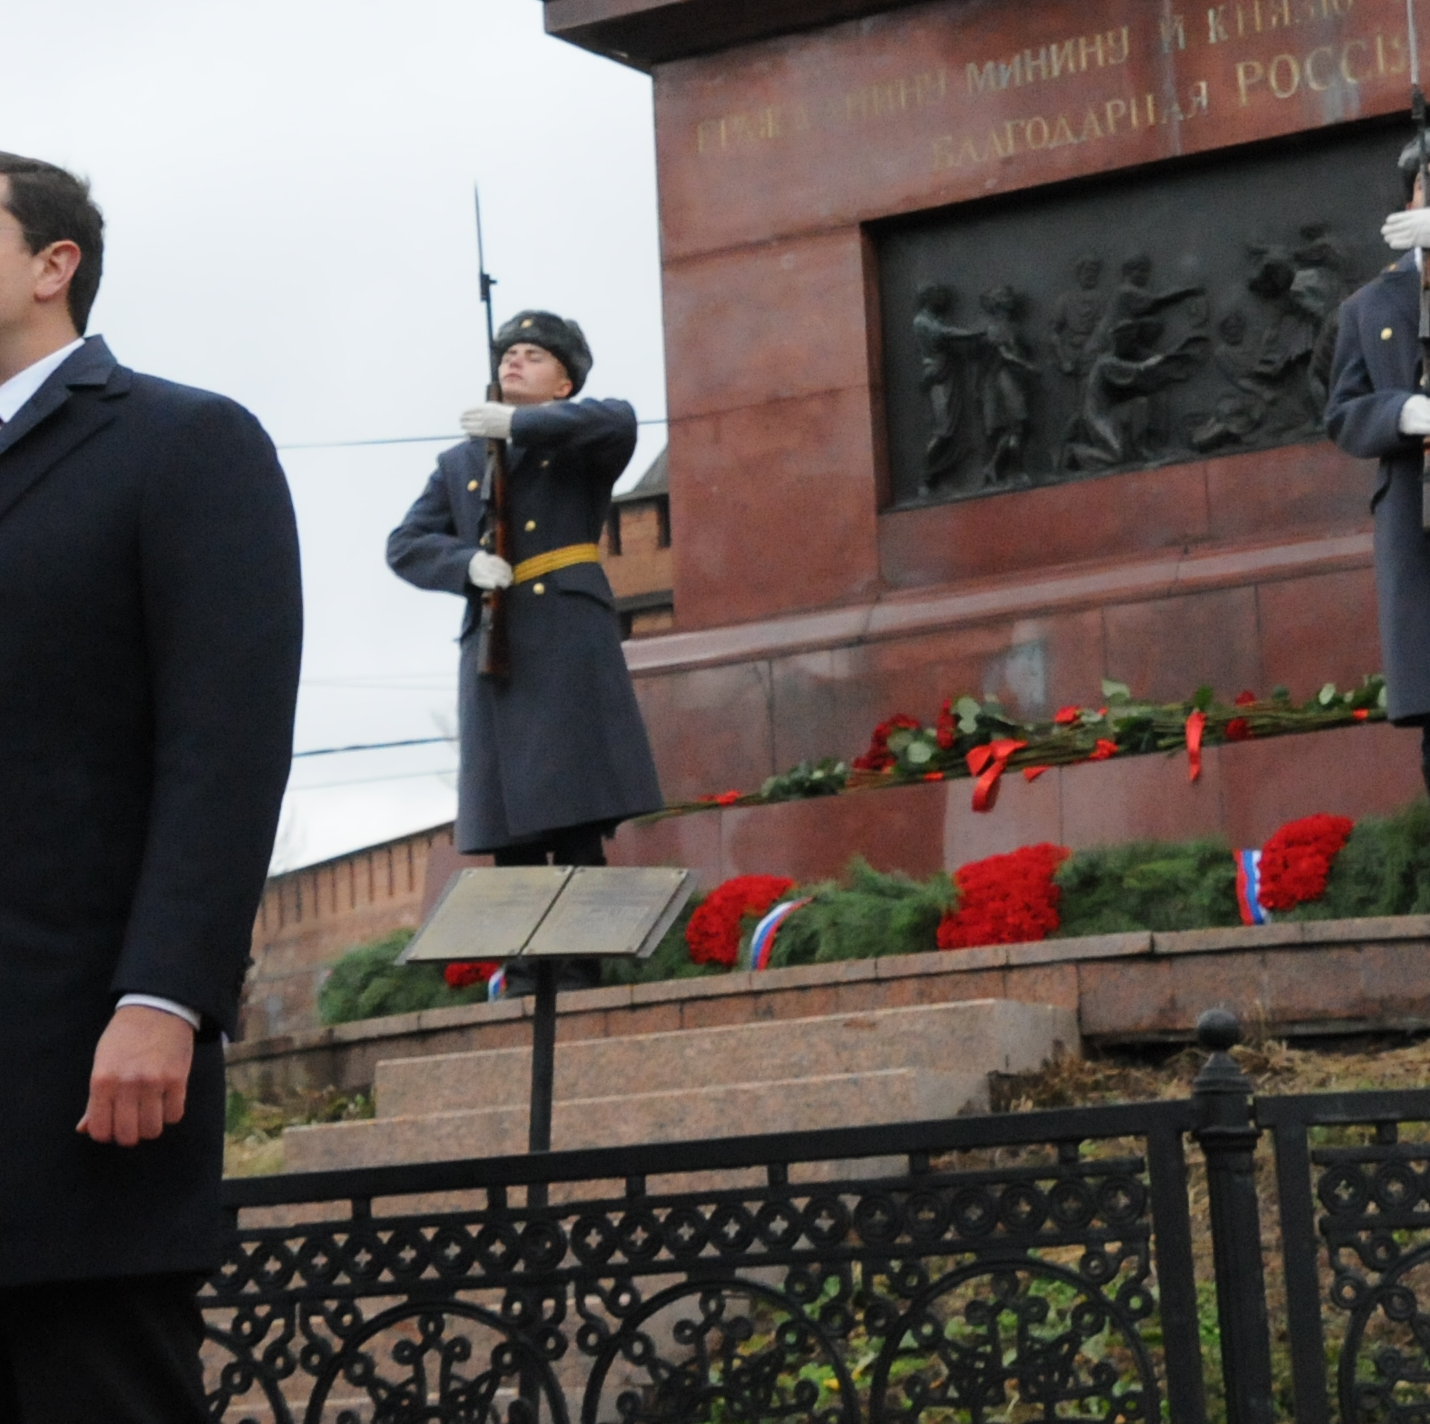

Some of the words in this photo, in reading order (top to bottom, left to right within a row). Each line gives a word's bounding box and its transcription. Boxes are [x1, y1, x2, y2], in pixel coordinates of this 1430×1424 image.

[696, 67, 945, 156] ГРАЖНИНУ
[966, 24, 1130, 96] МИНИНУ
[931, 80, 1209, 172] БЛАГОДАРНАЯ
